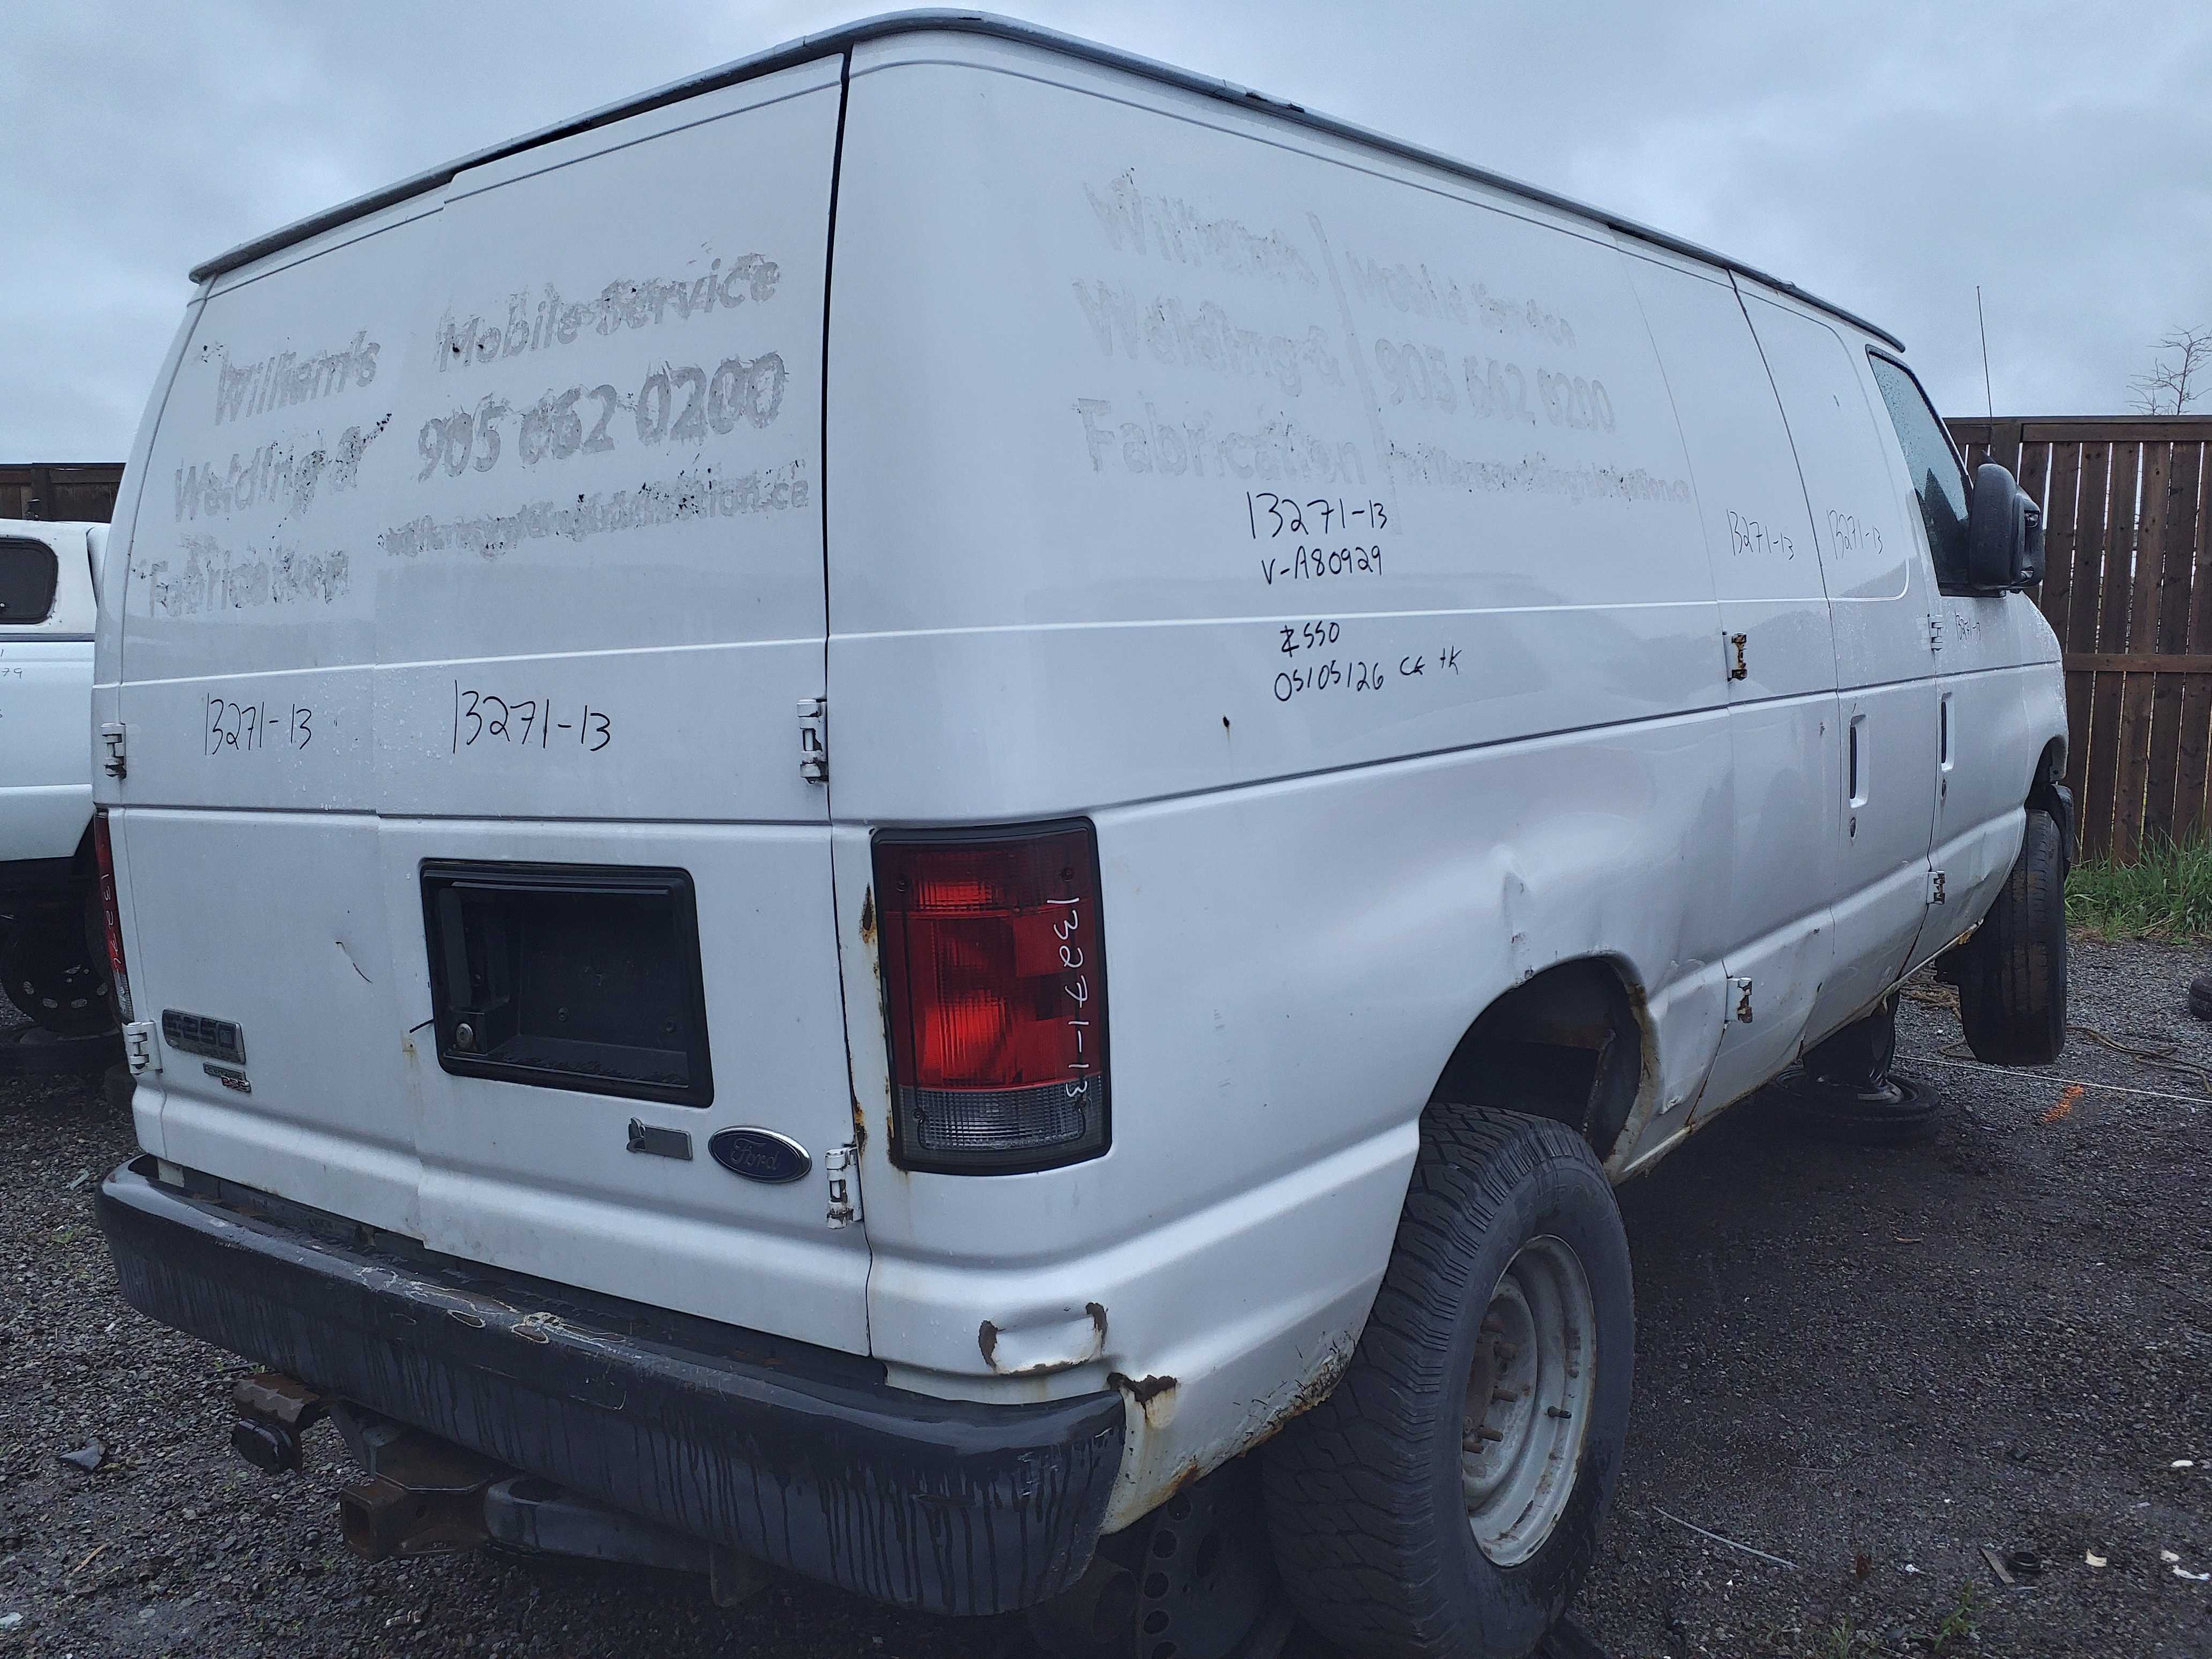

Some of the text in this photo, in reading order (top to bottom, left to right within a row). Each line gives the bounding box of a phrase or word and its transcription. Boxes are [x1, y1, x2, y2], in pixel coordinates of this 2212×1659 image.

[417, 398, 502, 483] 905
[638, 352, 787, 446] 0200
[1246, 491, 1387, 539] 13271-13
[1261, 545, 1382, 585] V-A80929
[204, 692, 313, 756] 13271-13
[452, 679, 611, 754] 13271-13
[1046, 896, 1090, 1098] 13271-13
[729, 1137, 781, 1171] Ford
